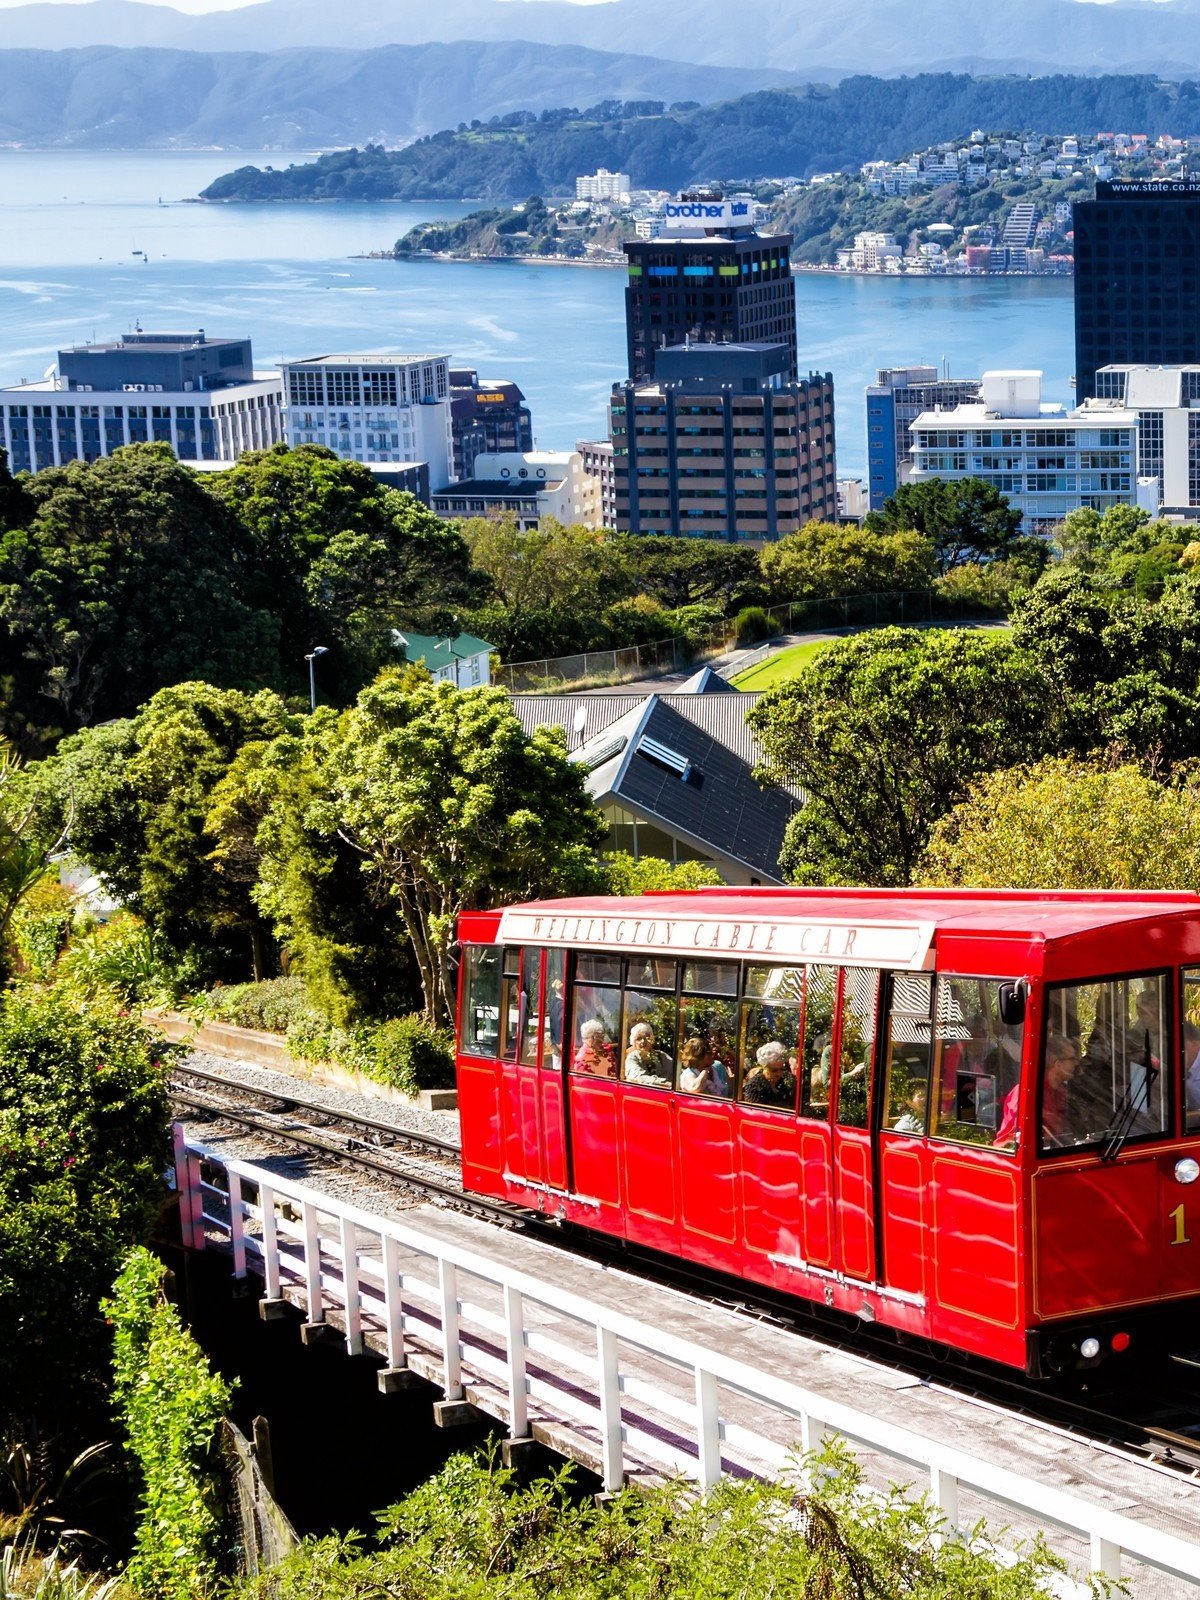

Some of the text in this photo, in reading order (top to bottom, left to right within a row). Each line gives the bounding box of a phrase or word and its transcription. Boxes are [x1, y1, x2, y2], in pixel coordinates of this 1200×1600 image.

[666, 203, 724, 217] brother
[533, 917, 857, 955] WELLINGTON CABLE CAR
[1168, 1203, 1190, 1245] 1
